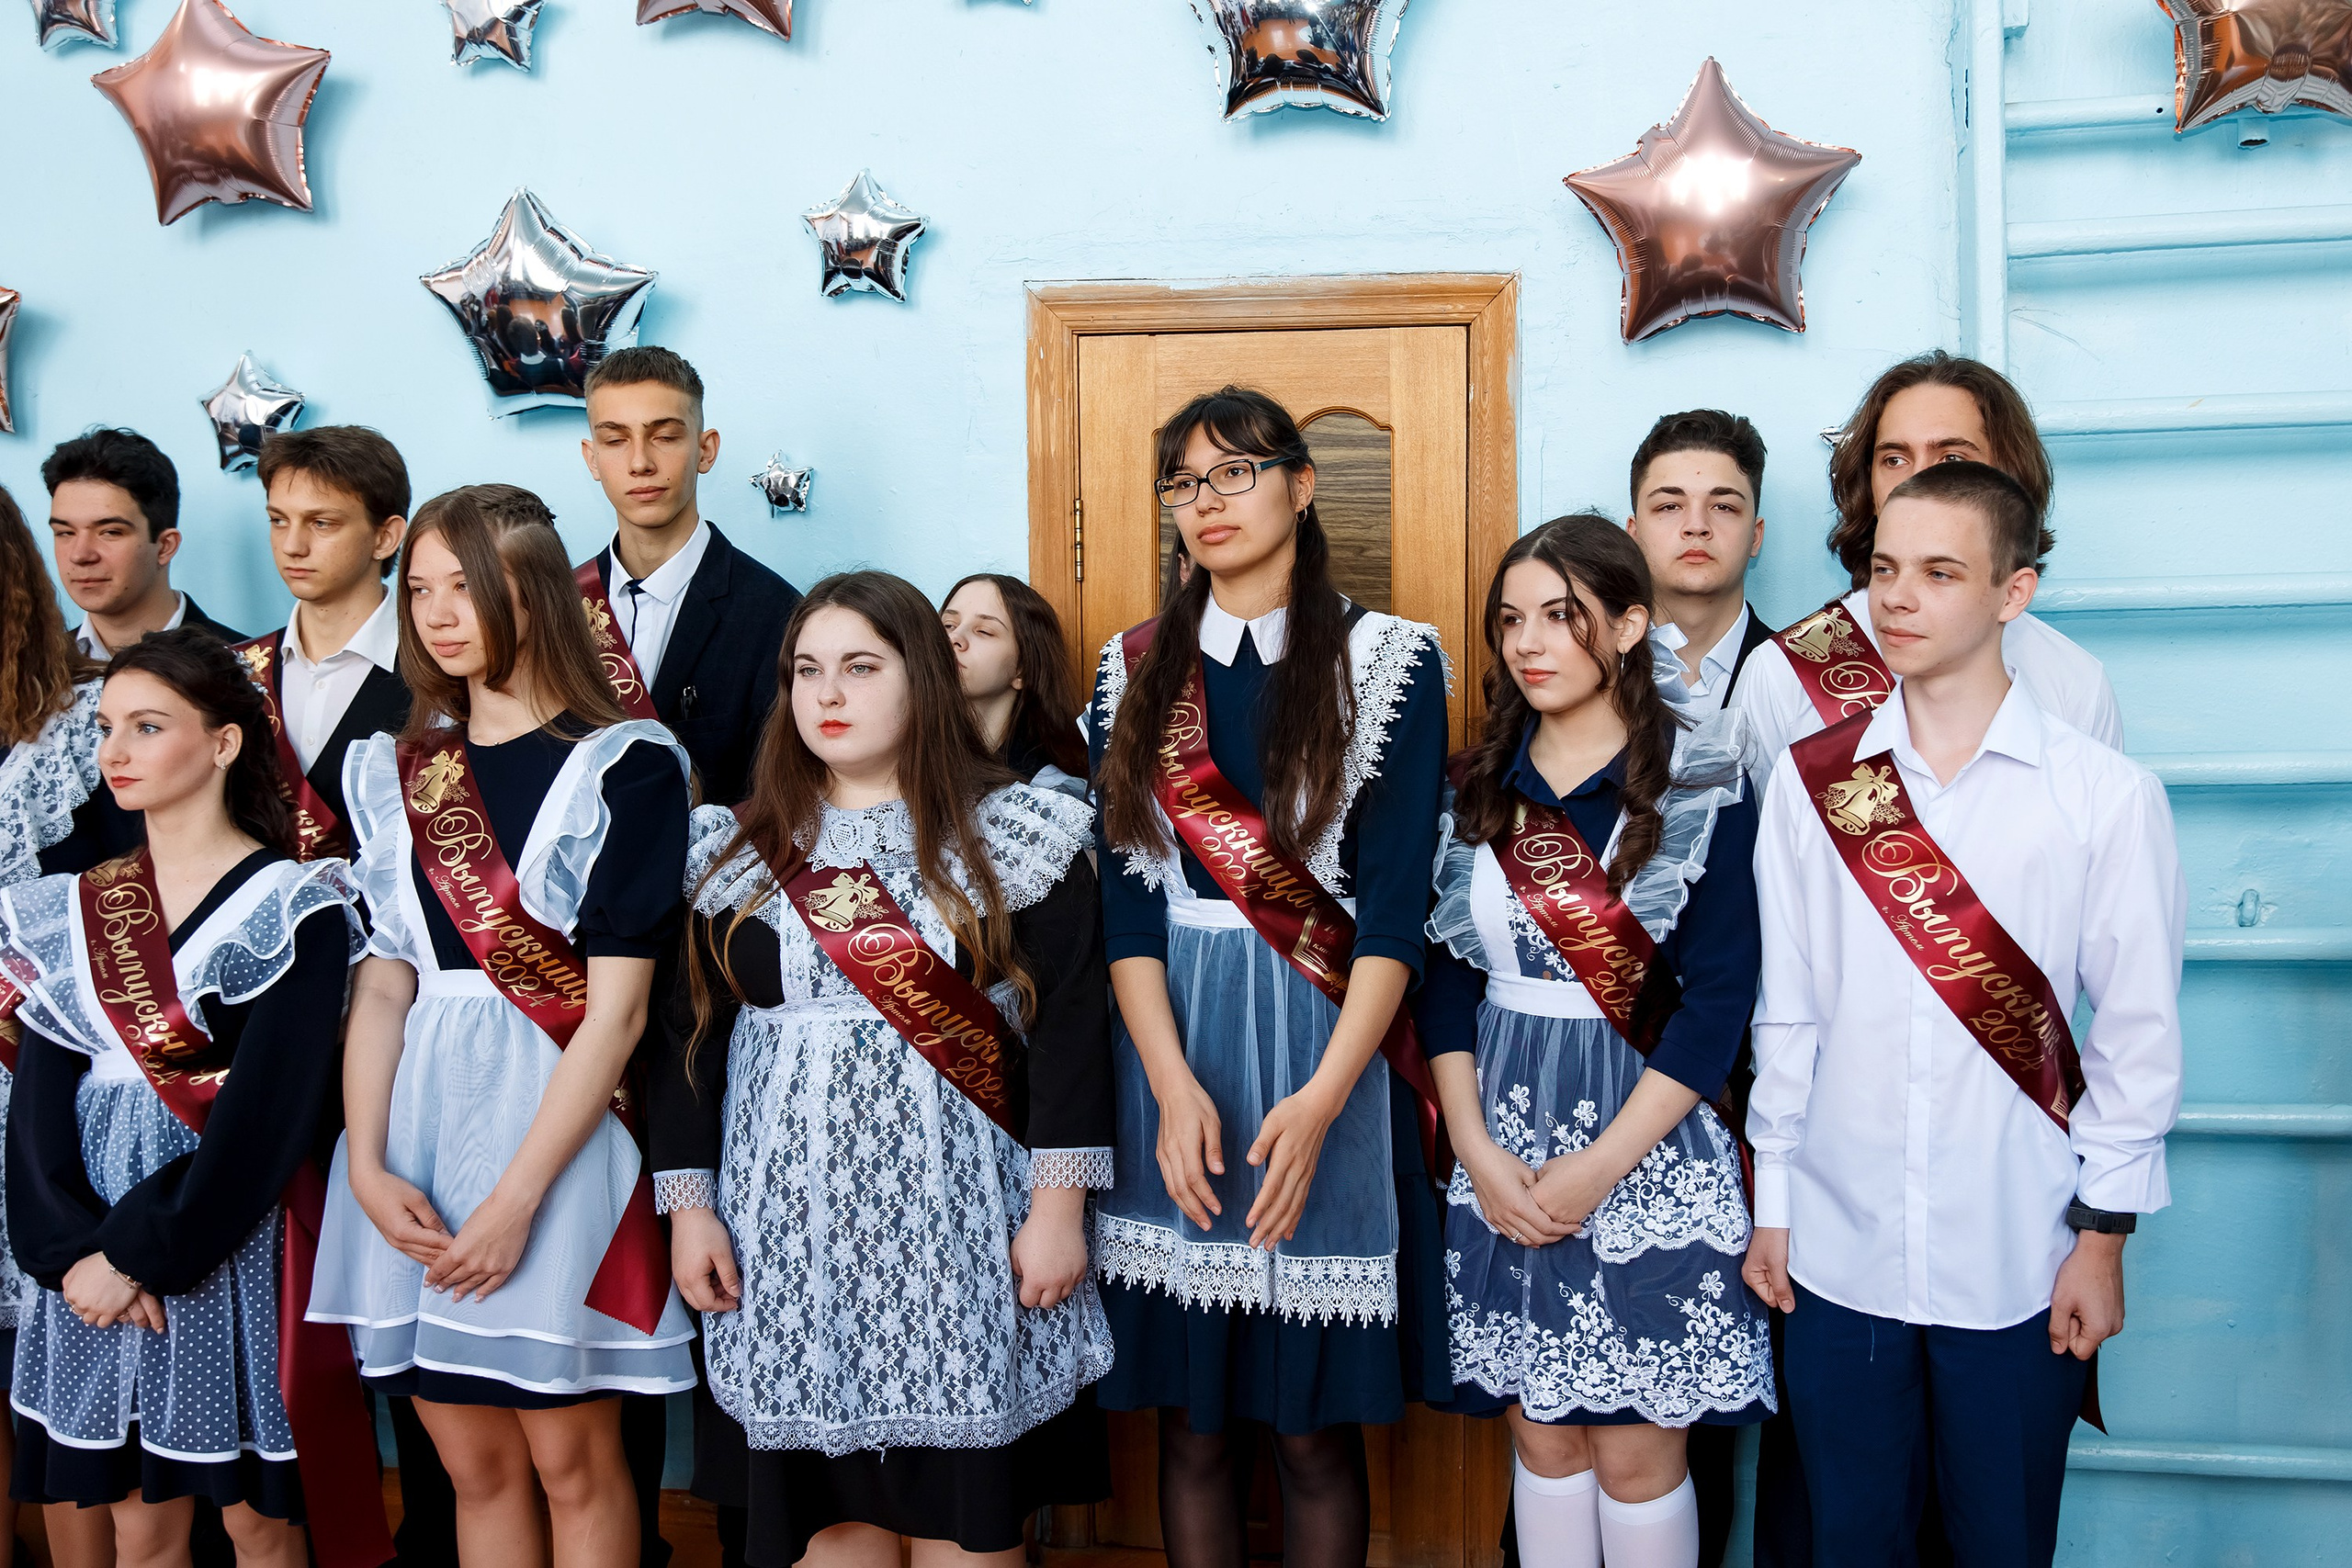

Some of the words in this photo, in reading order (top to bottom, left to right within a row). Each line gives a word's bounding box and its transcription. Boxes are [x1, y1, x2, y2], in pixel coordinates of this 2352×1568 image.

[1198, 837, 1253, 898] 2024
[426, 807, 588, 1010] Выпускниц
[1861, 829, 2061, 1055] Выпускник
[482, 952, 558, 1008] 2024
[1585, 970, 1639, 1021] 202
[1969, 1010, 2045, 1072] 2024
